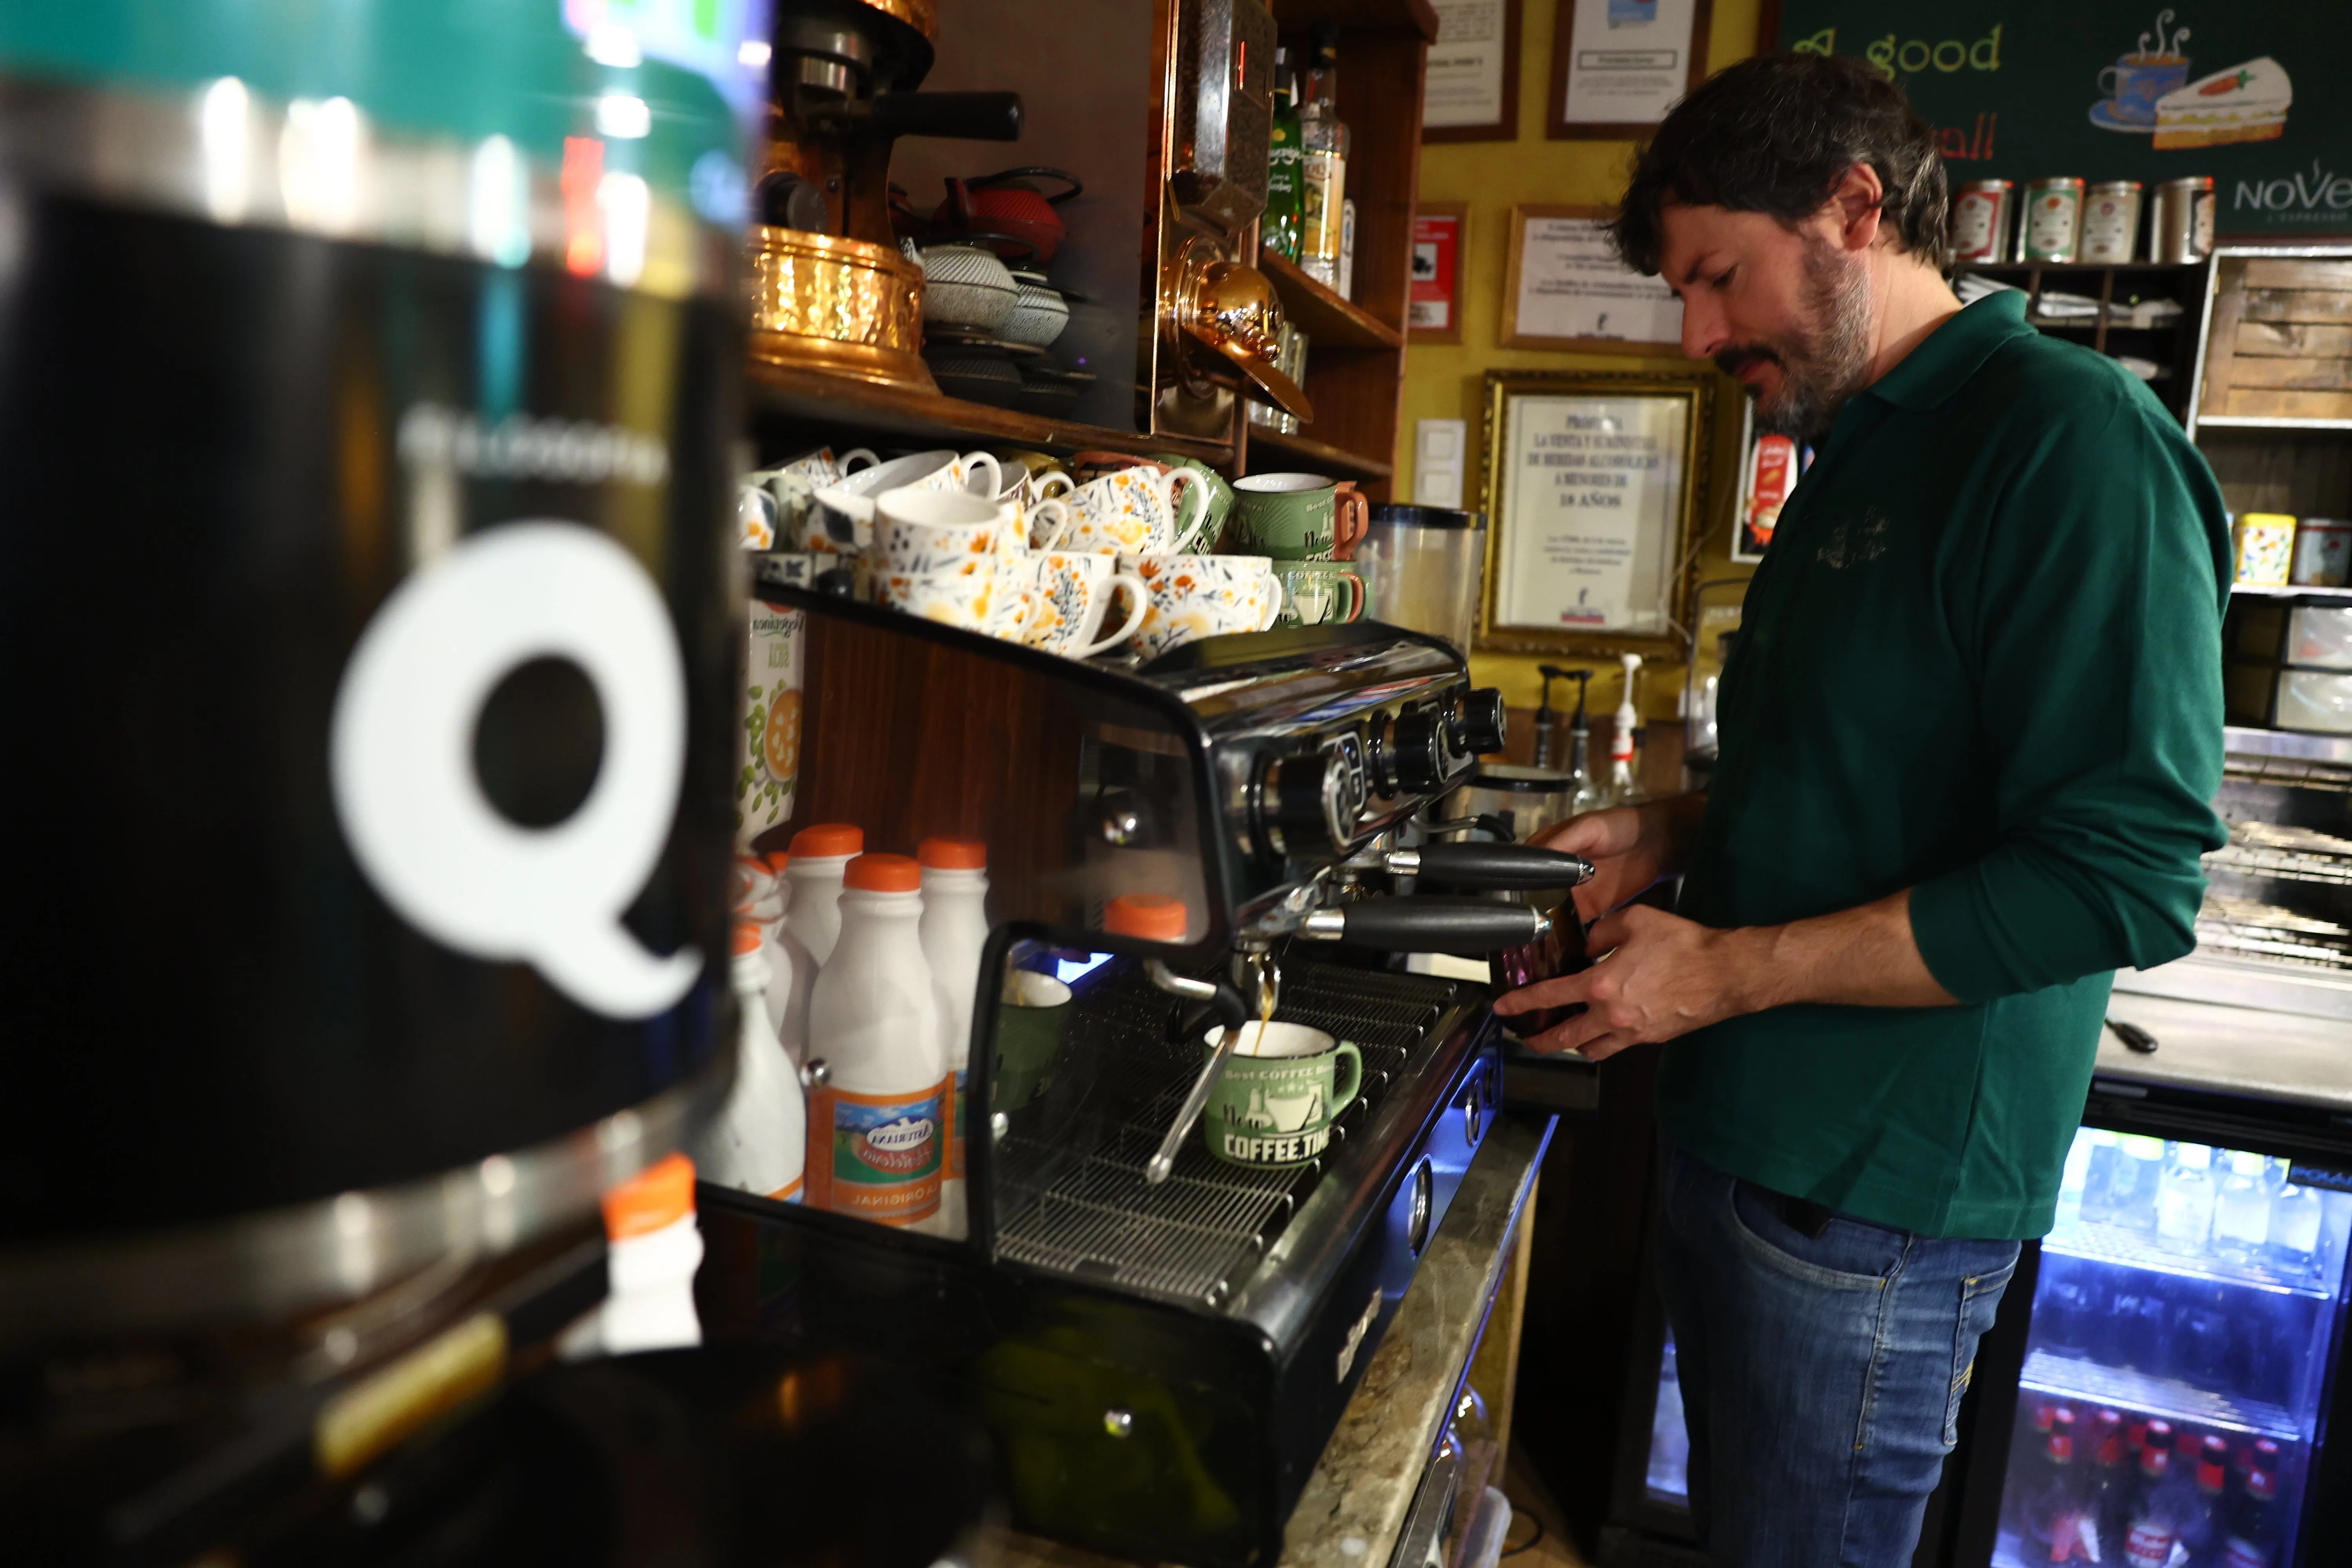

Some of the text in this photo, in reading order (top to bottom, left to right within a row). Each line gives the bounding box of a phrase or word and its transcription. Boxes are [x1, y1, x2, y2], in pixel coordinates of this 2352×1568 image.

[1866, 23, 2003, 82] good
[1932, 112, 1996, 160] all
[329, 520, 704, 1020] Q
[1224, 1069, 1255, 1080] Best
[1259, 1066, 1314, 1080] COFFEE
[1224, 1134, 1298, 1162] COFFEE
